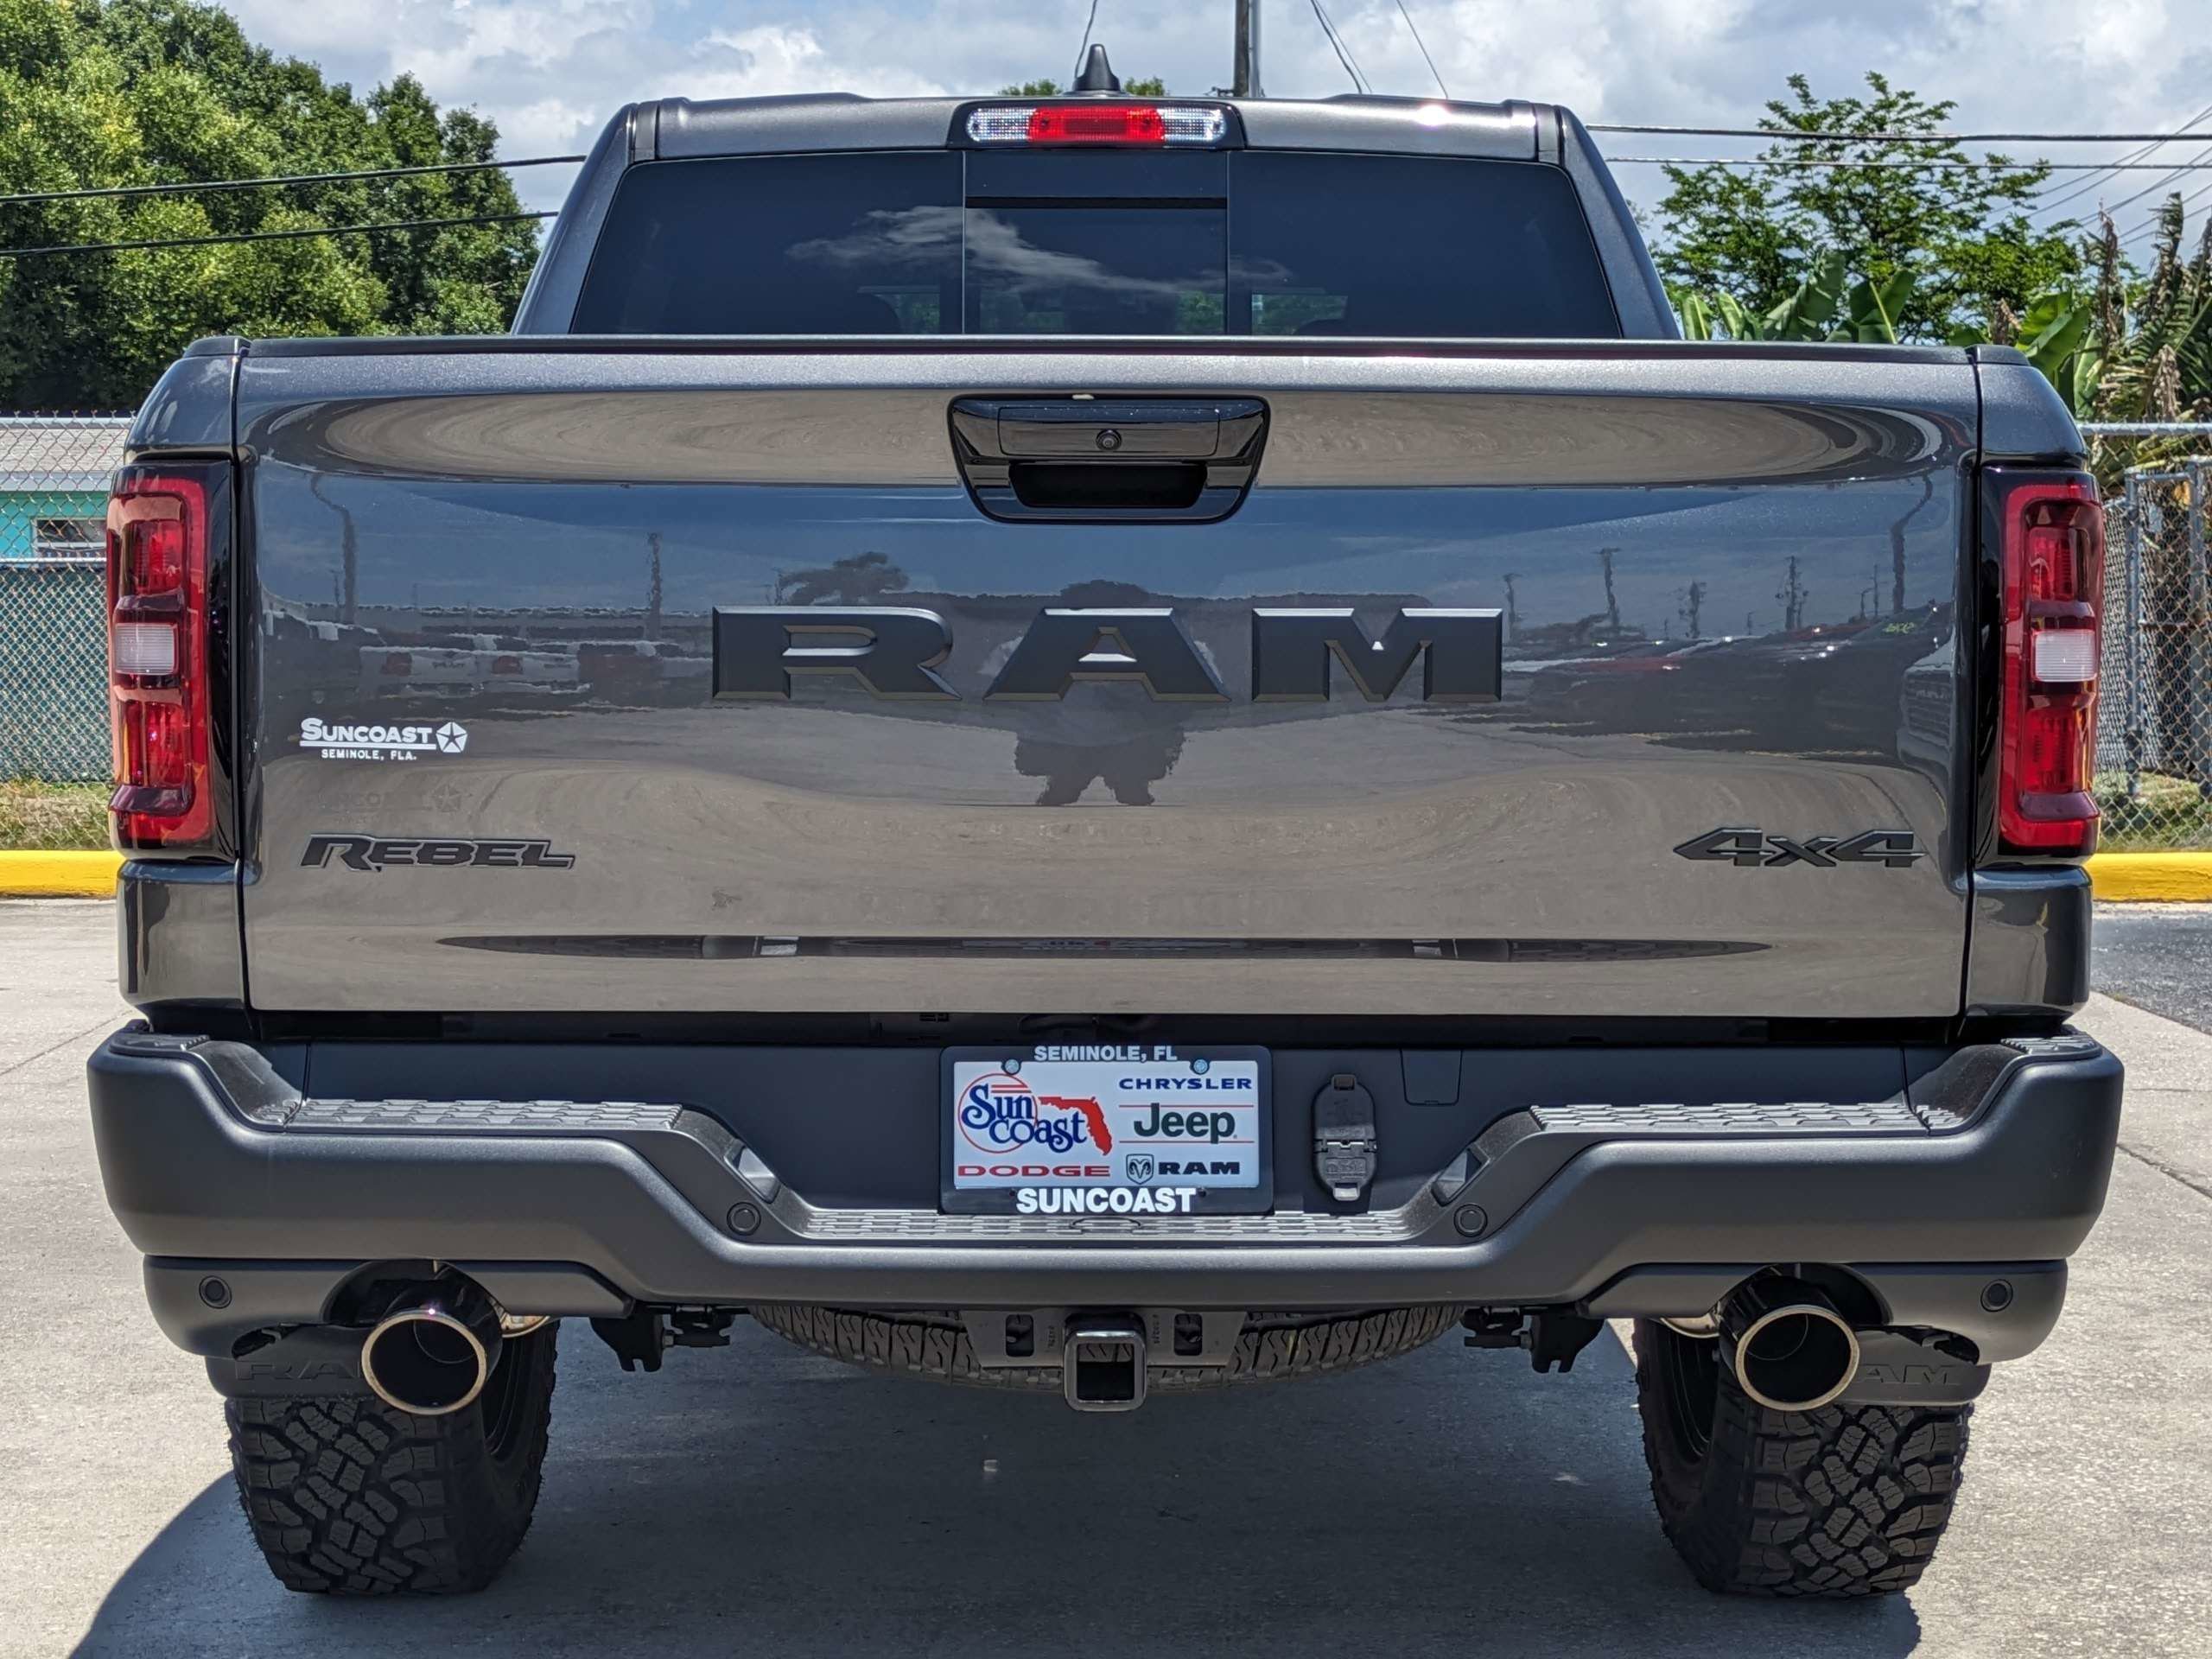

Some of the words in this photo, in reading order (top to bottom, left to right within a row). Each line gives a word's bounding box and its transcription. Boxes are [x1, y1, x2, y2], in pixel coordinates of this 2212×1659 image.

[712, 605, 1502, 702] RAM
[301, 717, 433, 743] SUNCOAST
[321, 749, 385, 761] SEMINOLE,
[391, 749, 417, 760] FLA.
[300, 833, 575, 873] REBEL
[1033, 1046, 1147, 1062] SEMINOLE,
[1154, 1046, 1178, 1061] FL
[1119, 1077, 1252, 1090] CHRYSLER
[961, 1084, 1033, 1129] Sun
[1134, 1103, 1236, 1144] Jeep
[957, 1165, 1110, 1177] DODGE
[1159, 1161, 1240, 1175] RAM
[1016, 1187, 1197, 1213] SUNCOAST
[235, 1359, 363, 1382] RA
[1856, 1363, 1961, 1385] AM
